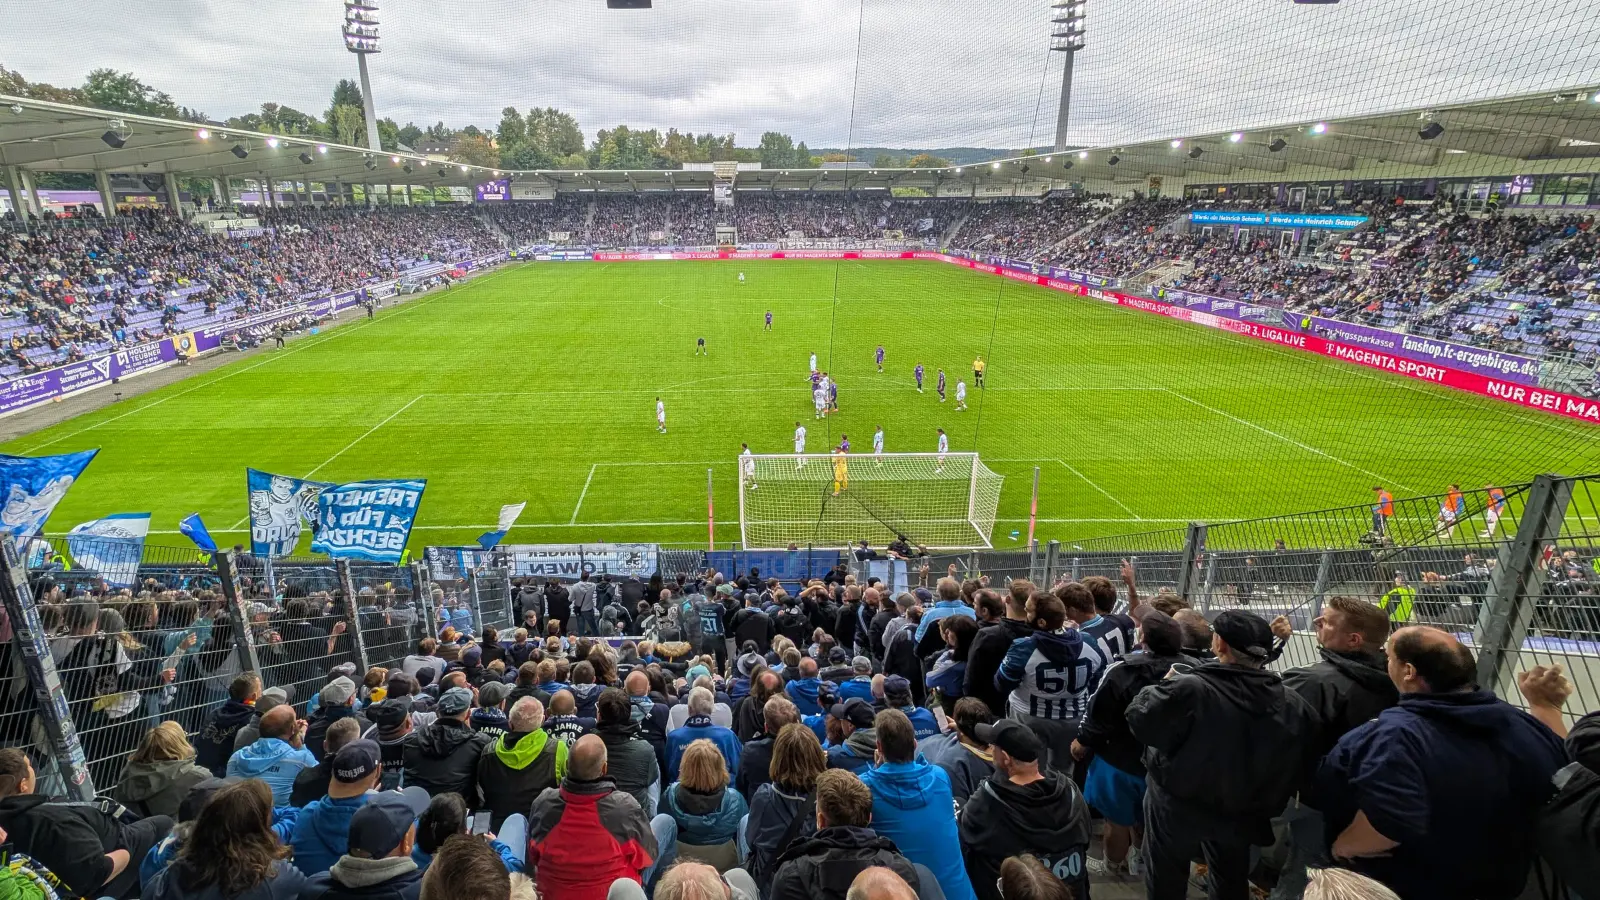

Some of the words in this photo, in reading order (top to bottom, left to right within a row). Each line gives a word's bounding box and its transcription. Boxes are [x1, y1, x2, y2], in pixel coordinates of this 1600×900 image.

[1305, 217, 1334, 225] Heinrich
[1091, 288, 1103, 300] LIGA
[1128, 298, 1157, 312] MAGENTA
[1252, 325, 1260, 337] 3.
[1261, 328, 1283, 342] LIGA
[1284, 333, 1306, 347] LIVE
[1314, 324, 1395, 348] Ebirgssparkasse
[128, 342, 160, 357] HOLZBAU
[130, 349, 162, 362] TEUBNER
[1336, 345, 1396, 370] MAGENTA
[1398, 360, 1446, 381] SPORT
[1487, 380, 1526, 402] NUR
[1529, 391, 1561, 410] BEI
[1566, 399, 1600, 420] MA
[1096, 627, 1126, 665] 17
[1035, 657, 1092, 694] 60
[554, 722, 584, 734] JAHRE
